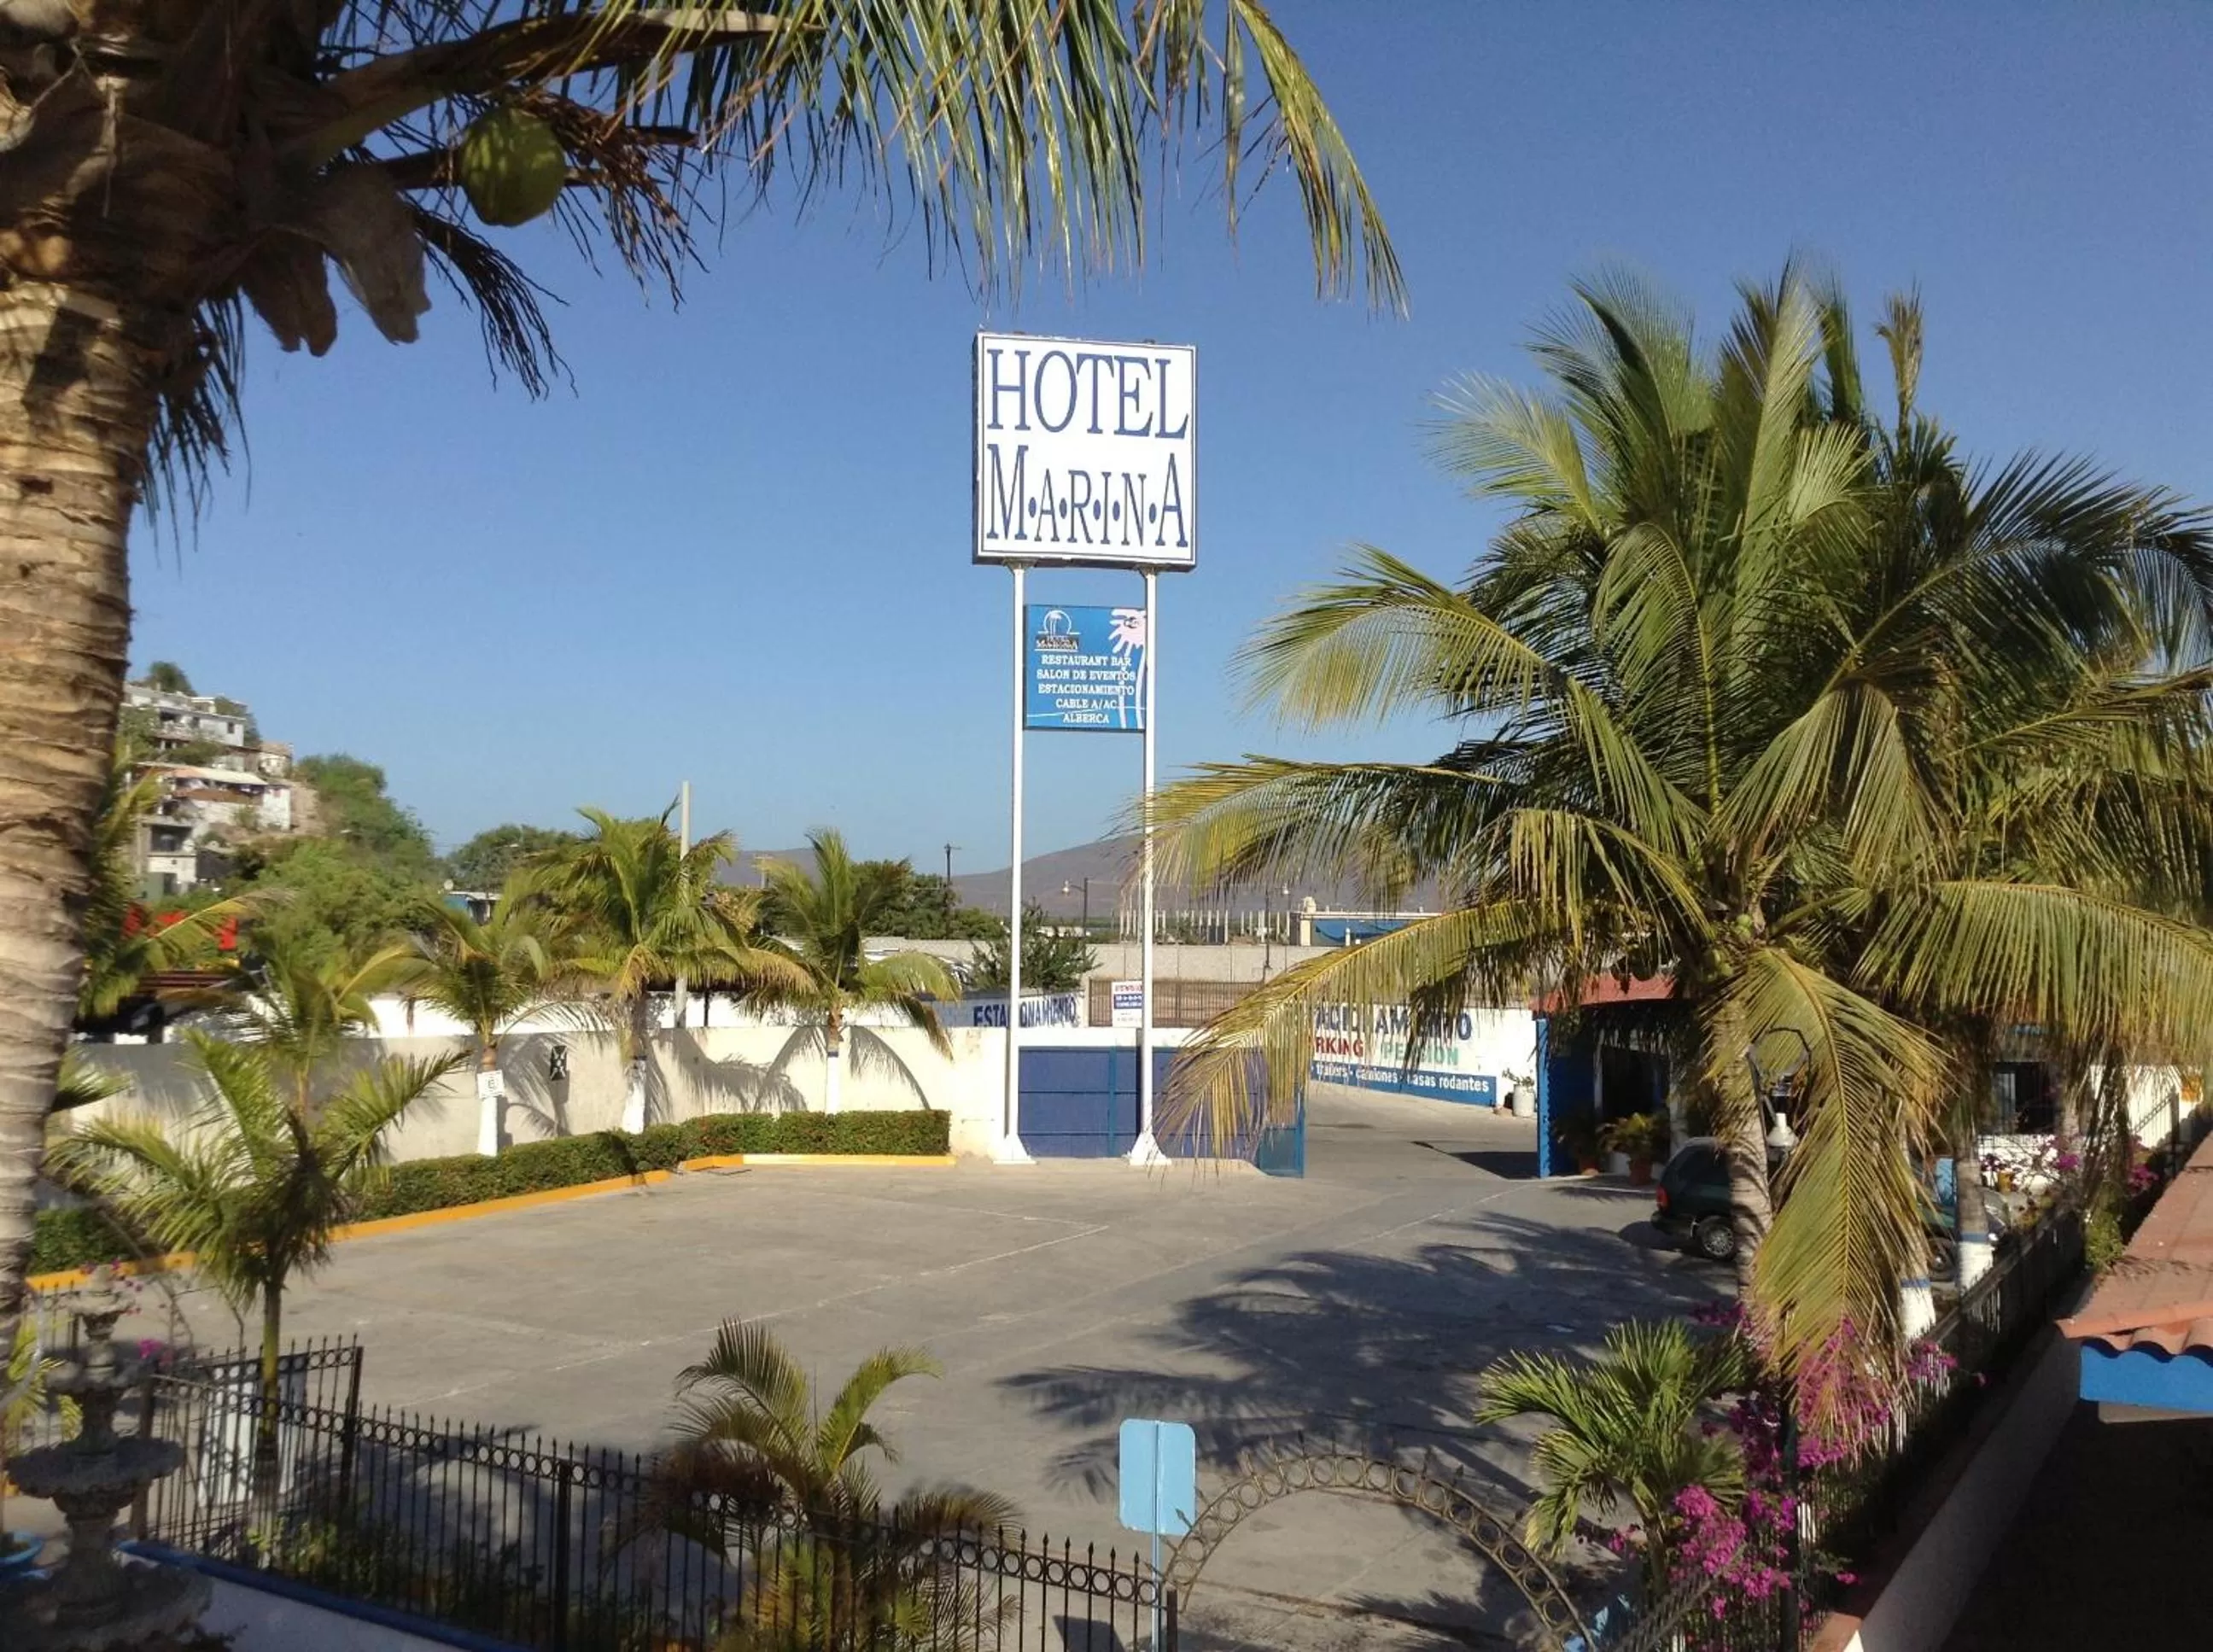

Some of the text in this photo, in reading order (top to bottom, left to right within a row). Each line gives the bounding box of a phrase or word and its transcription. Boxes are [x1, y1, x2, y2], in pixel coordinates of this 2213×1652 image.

[986, 348, 1189, 440] HOTEL
[1042, 655, 1131, 666] RESTAURANT BAR
[1036, 669, 1136, 680] SALON DE EVENTOS
[1038, 684, 1134, 696] ESTACIONAMIENTO
[1056, 699, 1088, 709] CABLE
[1063, 714, 1109, 723] ALBERCA
[1315, 1036, 1365, 1058] RKING
[1439, 1074, 1489, 1093] rodantes
